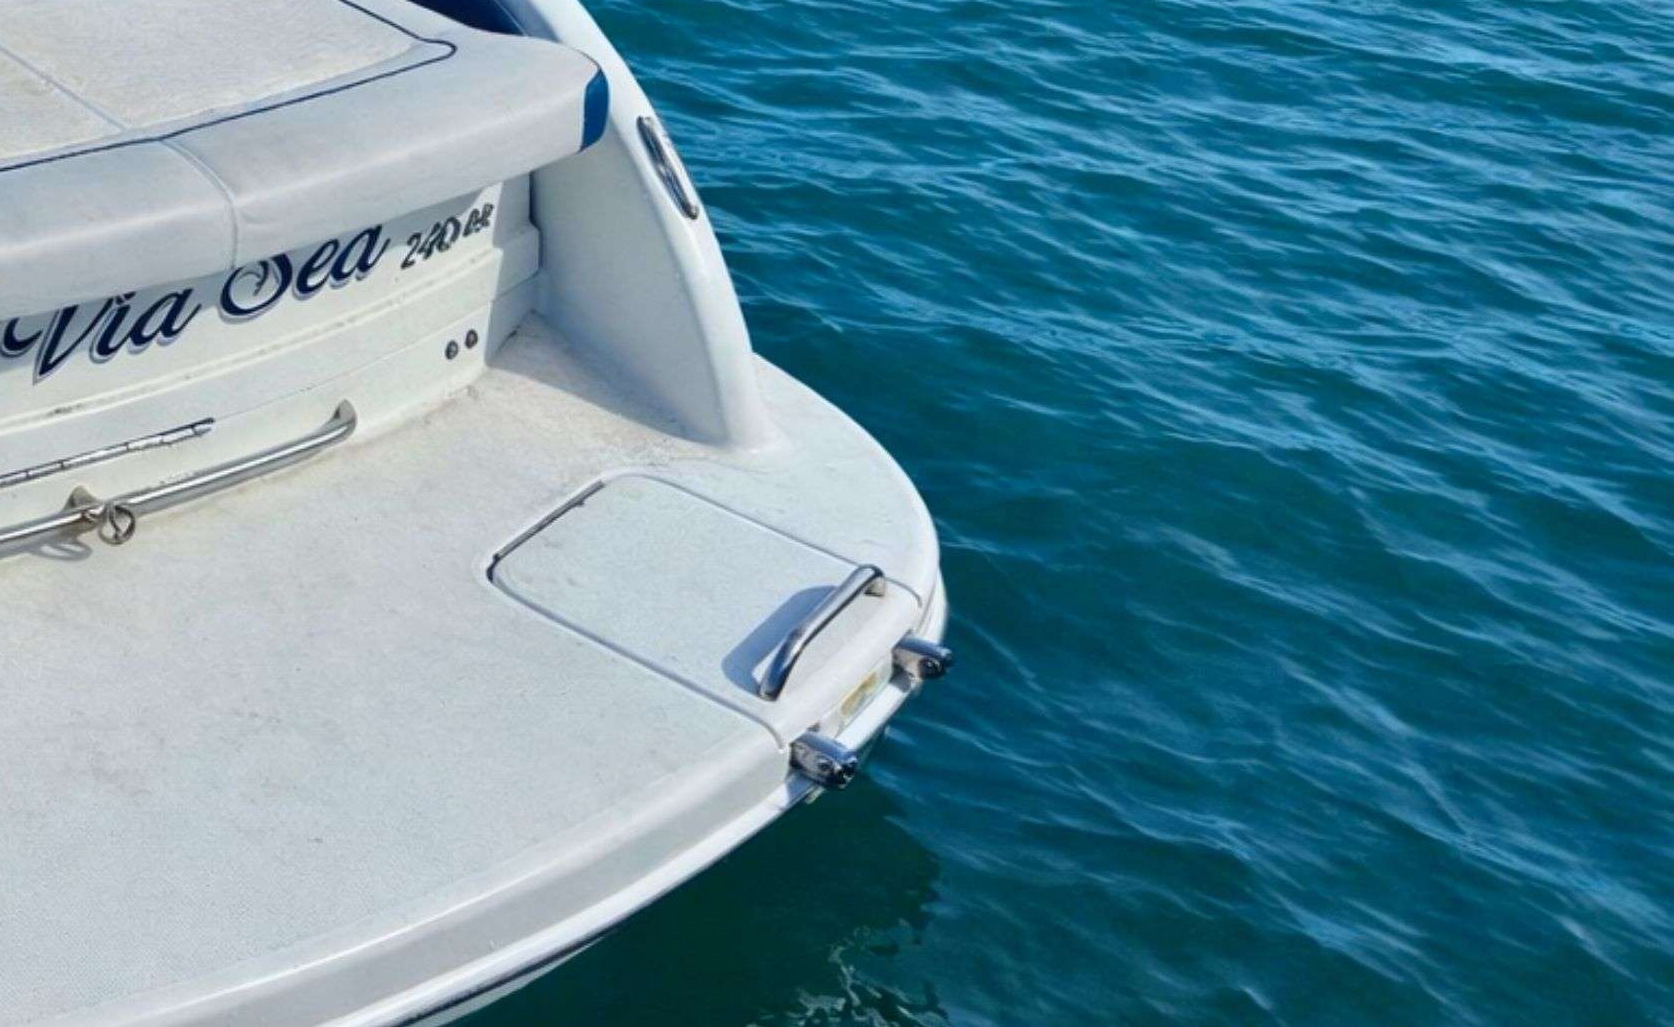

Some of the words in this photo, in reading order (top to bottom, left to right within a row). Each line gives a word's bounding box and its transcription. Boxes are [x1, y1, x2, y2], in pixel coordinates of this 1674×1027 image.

[400, 216, 462, 270] 240
[1, 291, 202, 378] Via
[219, 225, 391, 319] Sea
